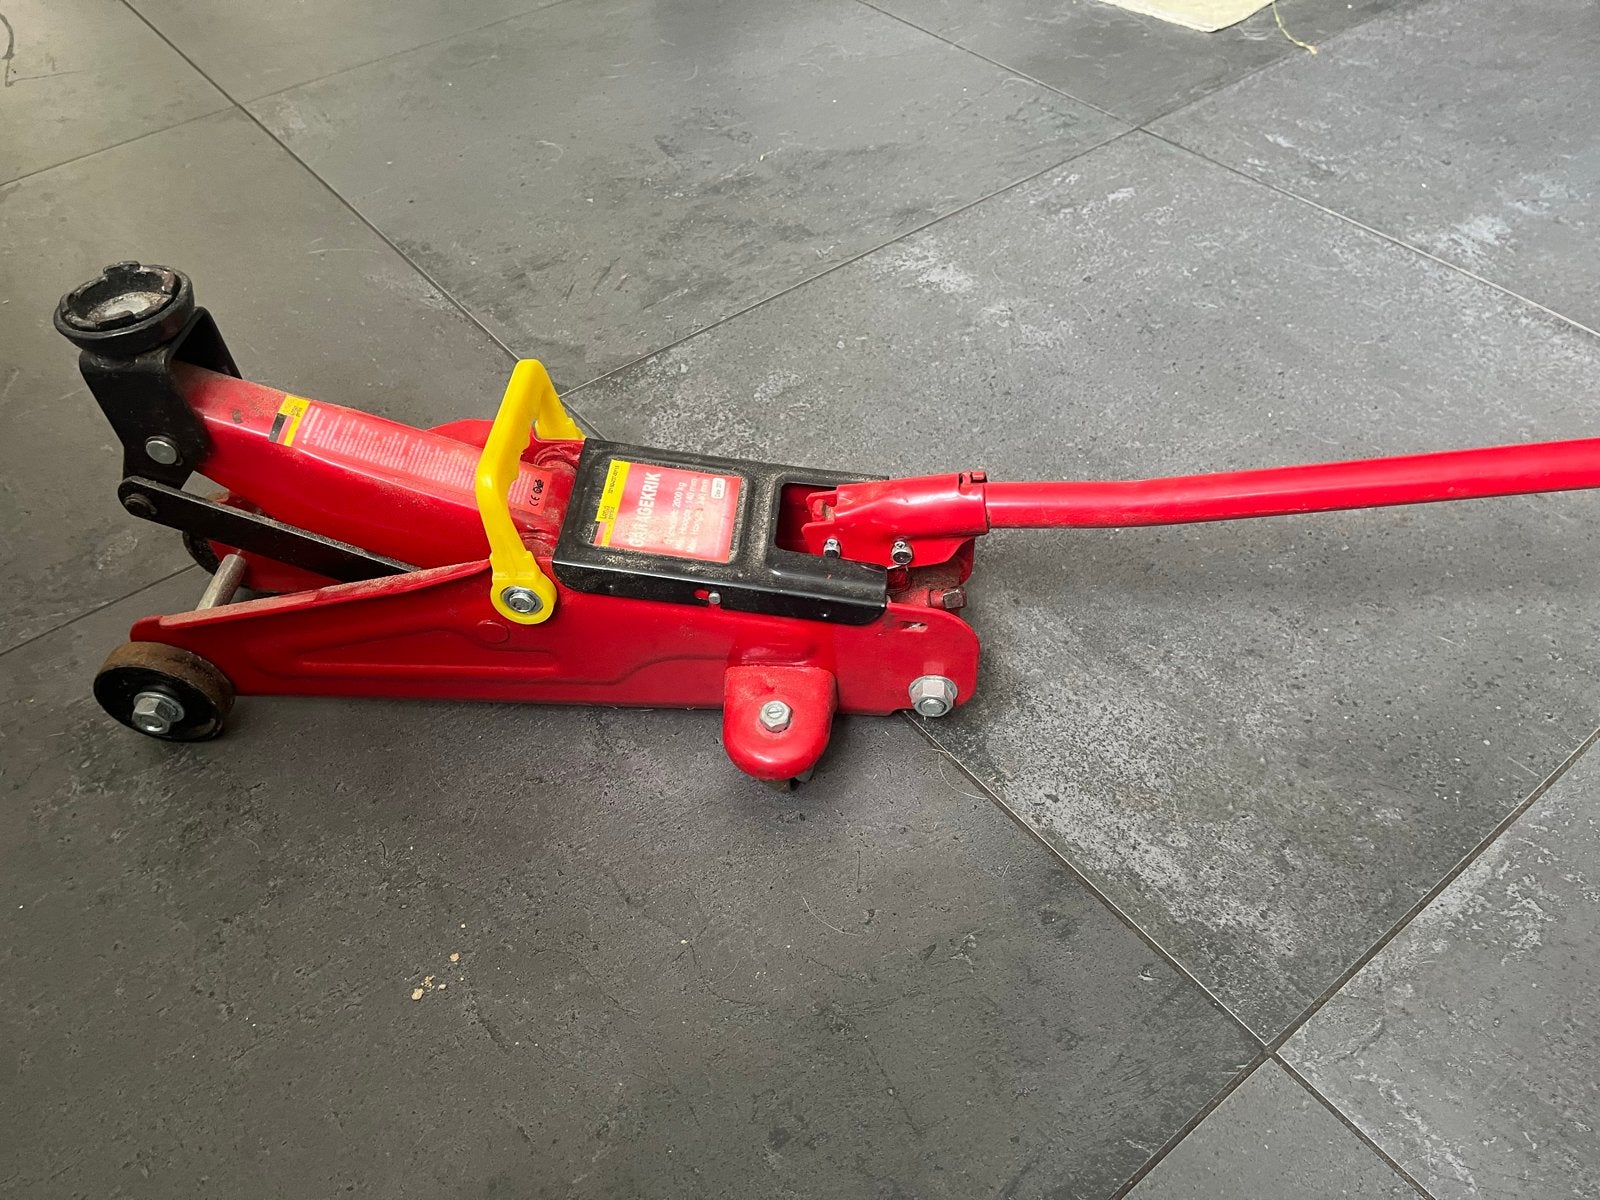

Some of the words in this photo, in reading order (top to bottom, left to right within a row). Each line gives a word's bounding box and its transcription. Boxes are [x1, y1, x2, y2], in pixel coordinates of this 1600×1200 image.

[676, 481, 687, 491] kg
[529, 494, 540, 506] CE
[672, 491, 683, 507] 2000
[628, 471, 662, 546] GARAGEKRIK
